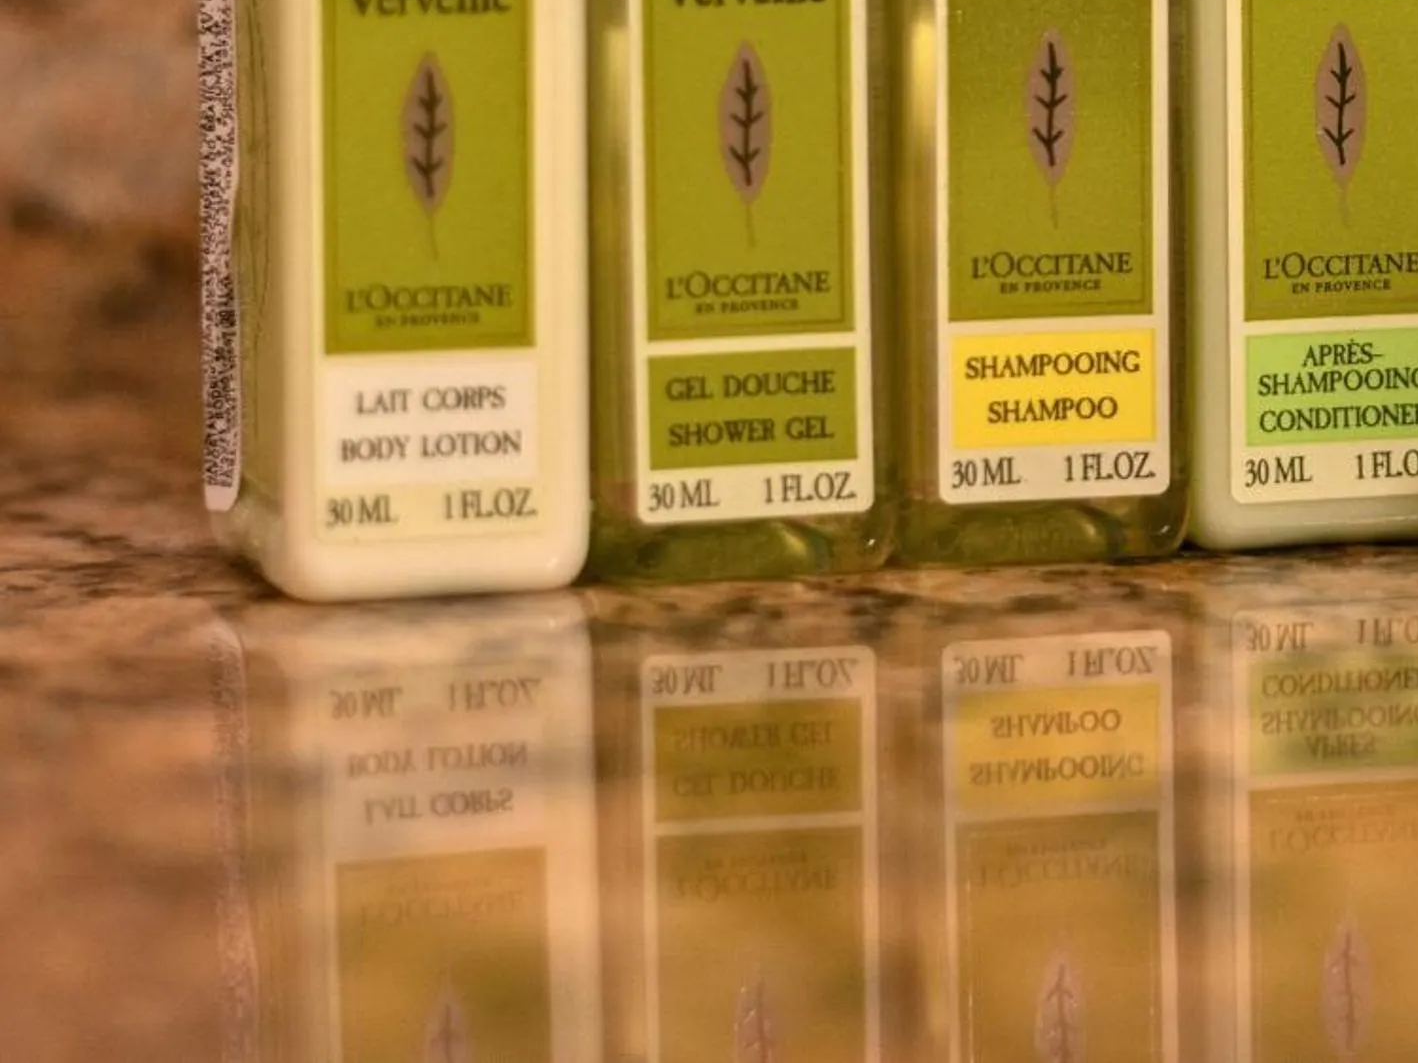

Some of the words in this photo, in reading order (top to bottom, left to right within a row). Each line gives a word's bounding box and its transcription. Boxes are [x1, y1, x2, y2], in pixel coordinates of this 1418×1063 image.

[1000, 283, 1019, 294] EN
[1025, 279, 1101, 293] PROVENCE
[1292, 283, 1309, 294] EN
[1315, 279, 1391, 293] PROVENCE
[401, 311, 480, 326] PROVENCE
[696, 302, 714, 314] EN
[721, 298, 799, 313] PROVENCE
[965, 350, 1140, 380] SHAMPOOING
[356, 389, 411, 415] LAIT
[422, 385, 506, 411] CORPS
[665, 376, 714, 402] GEL
[722, 370, 836, 398] DOUCHE
[987, 396, 1118, 424] SHAMPOO
[669, 418, 775, 447] SHOWER
[785, 415, 835, 439] GEL
[340, 435, 410, 463] BODY
[420, 429, 522, 458] LOTION
[952, 460, 977, 488] 30
[982, 456, 1021, 485] ML
[1065, 455, 1074, 482] 1
[1245, 458, 1269, 488] 30
[1274, 456, 1313, 484] ML
[1356, 453, 1365, 480] 1
[649, 483, 675, 512] 30
[680, 478, 720, 509] ML
[764, 477, 774, 504] 1
[326, 497, 353, 528] 30
[358, 494, 398, 525] ML
[444, 493, 454, 520] 1
